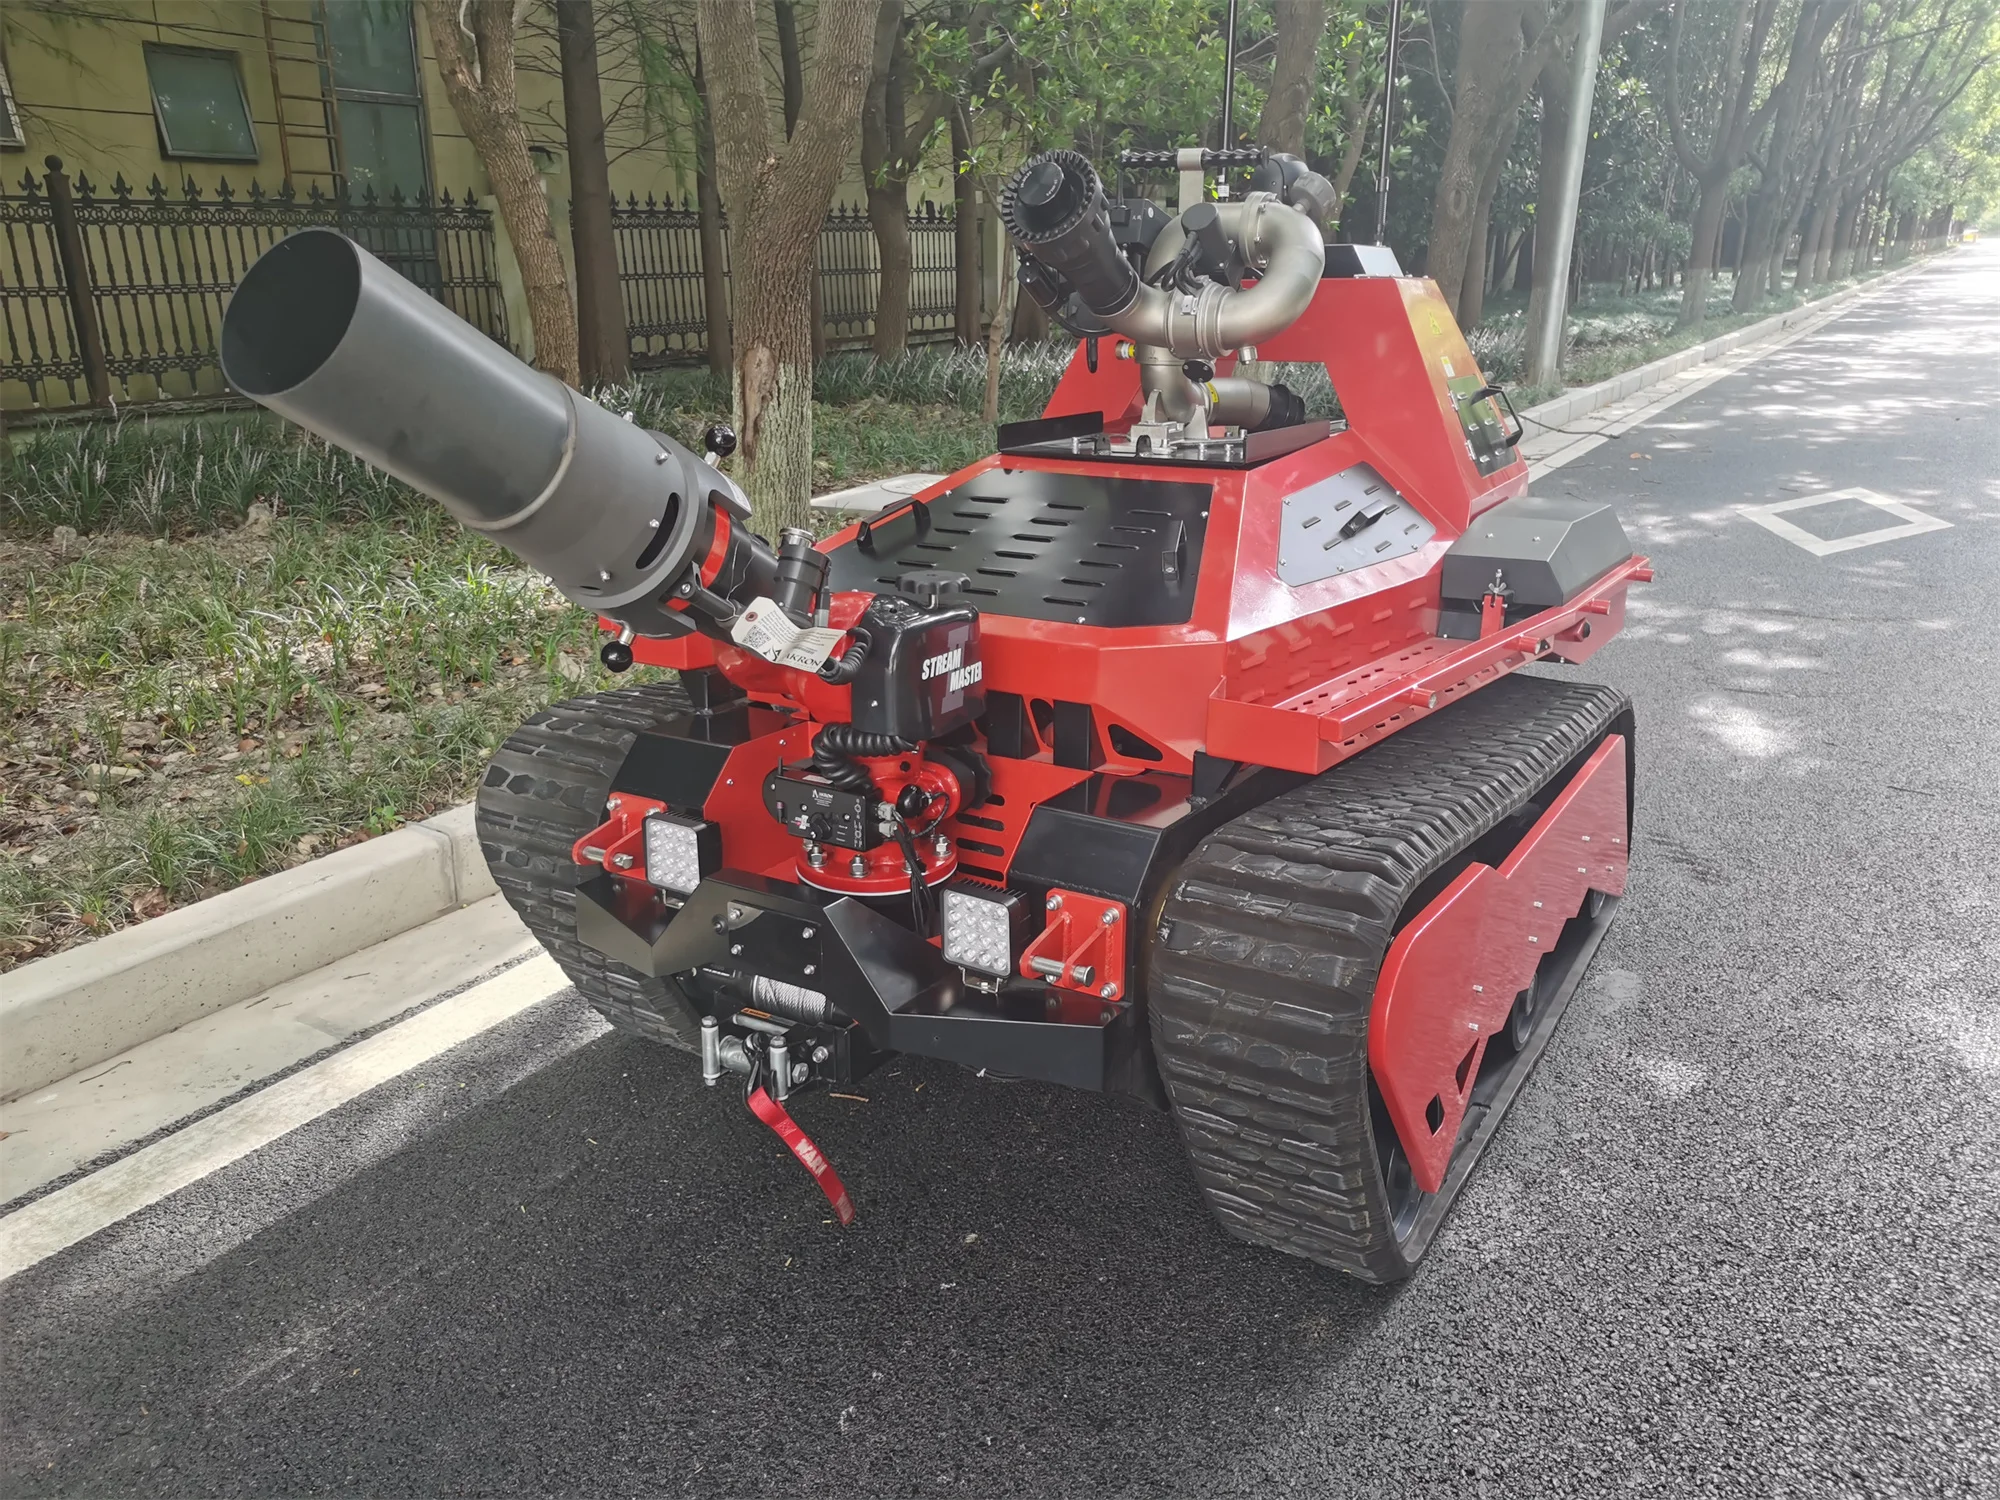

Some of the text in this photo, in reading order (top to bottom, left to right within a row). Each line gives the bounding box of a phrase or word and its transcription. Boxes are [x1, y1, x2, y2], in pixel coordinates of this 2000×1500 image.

[785, 652, 822, 667] AKRON
[921, 648, 962, 680] STREAM
[949, 661, 982, 692] MASTER
